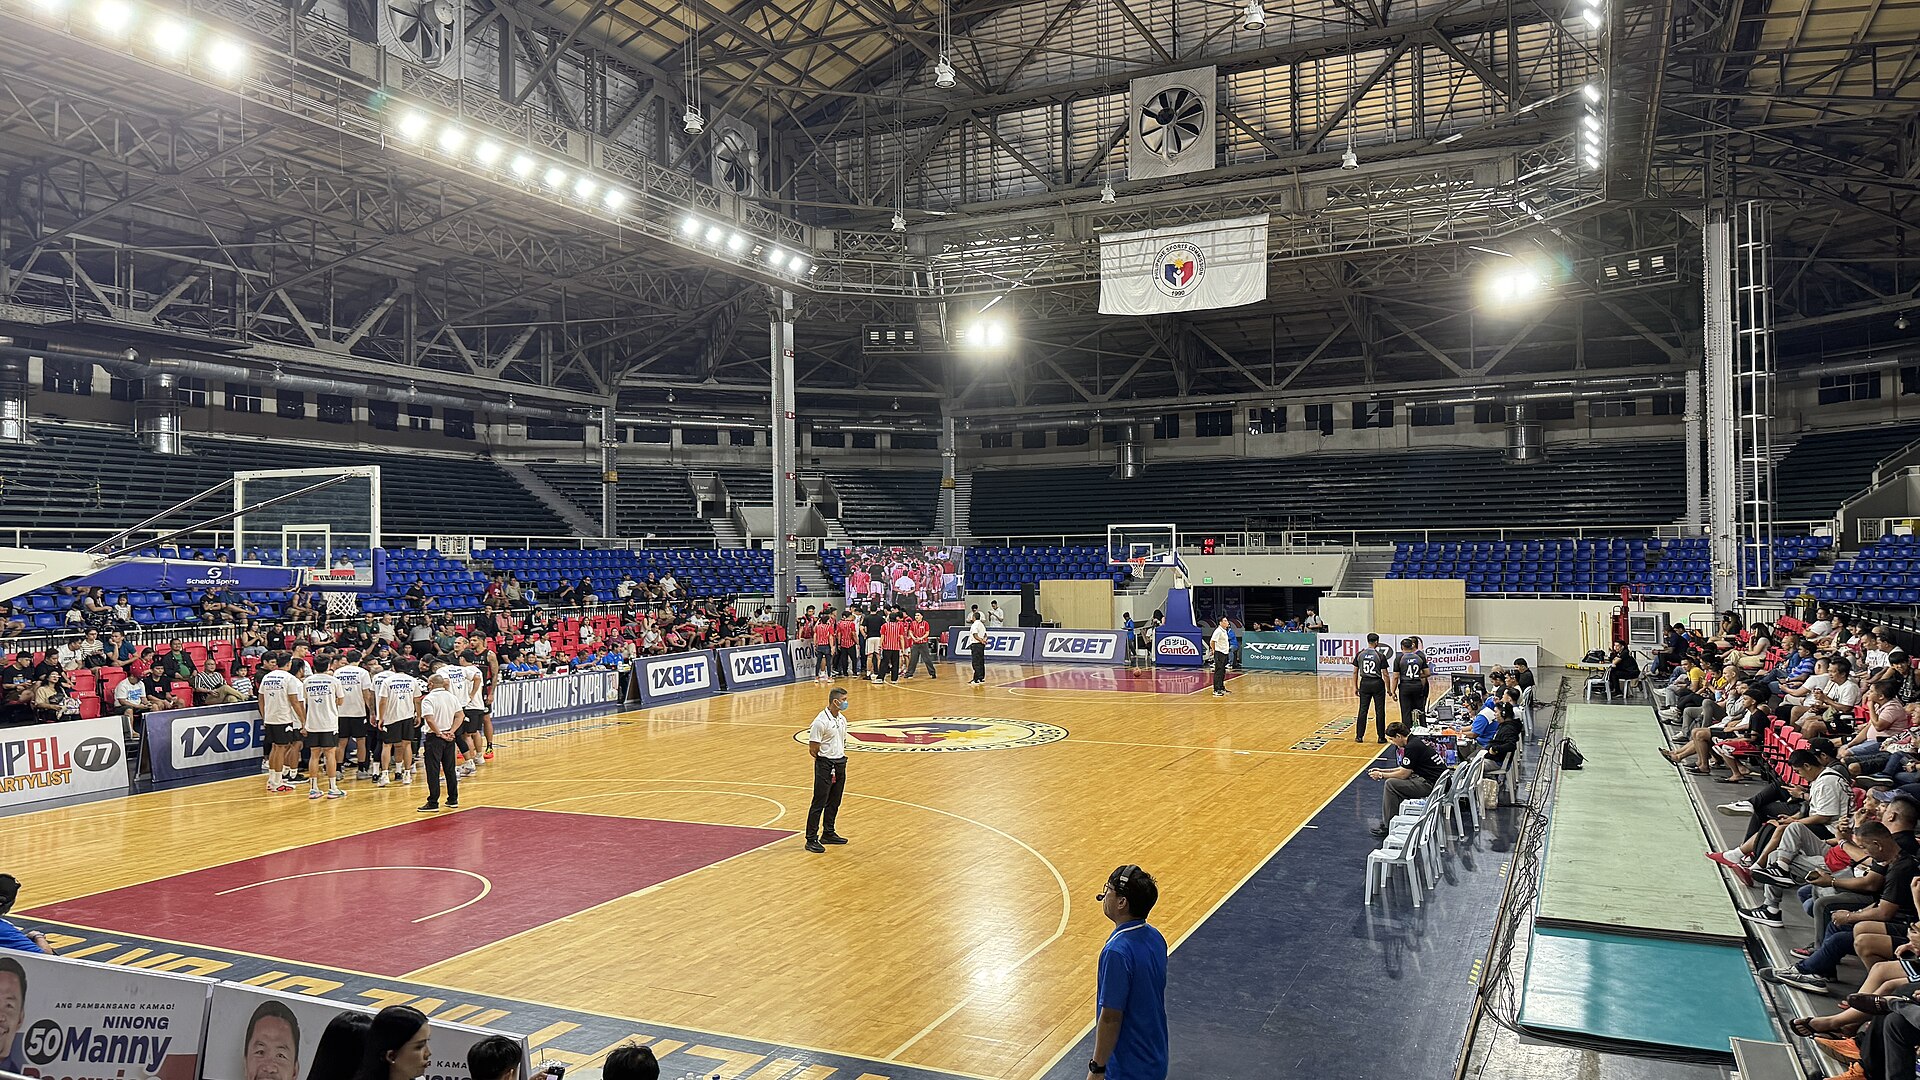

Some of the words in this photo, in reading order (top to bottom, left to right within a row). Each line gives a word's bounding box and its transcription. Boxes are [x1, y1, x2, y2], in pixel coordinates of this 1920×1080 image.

[1166, 244, 1188, 252] SPORTS
[215, 578, 240, 586] Sports
[959, 636, 1022, 651] 1BET
[1048, 637, 1113, 654] 1XBET
[1243, 642, 1311, 653] XTREME
[1437, 646, 1472, 655] Manny
[795, 643, 817, 660] mol
[1426, 654, 1471, 664] Pacquiao
[734, 653, 780, 677] 1XBET
[1362, 660, 1376, 674] 52
[1405, 664, 1419, 679] 42
[651, 662, 705, 690] 1XBET
[521, 675, 578, 714] PACQUIAO'S
[580, 672, 605, 706] MPBL
[82, 742, 113, 767] 77
[55, 1002, 73, 1010] ANG
[75, 1002, 136, 1010] PAMBANSANG
[139, 1003, 175, 1011] KAMAO!
[102, 1016, 170, 1030] NINONG
[26, 1027, 63, 1057] 50
[61, 1026, 173, 1073] Manny
